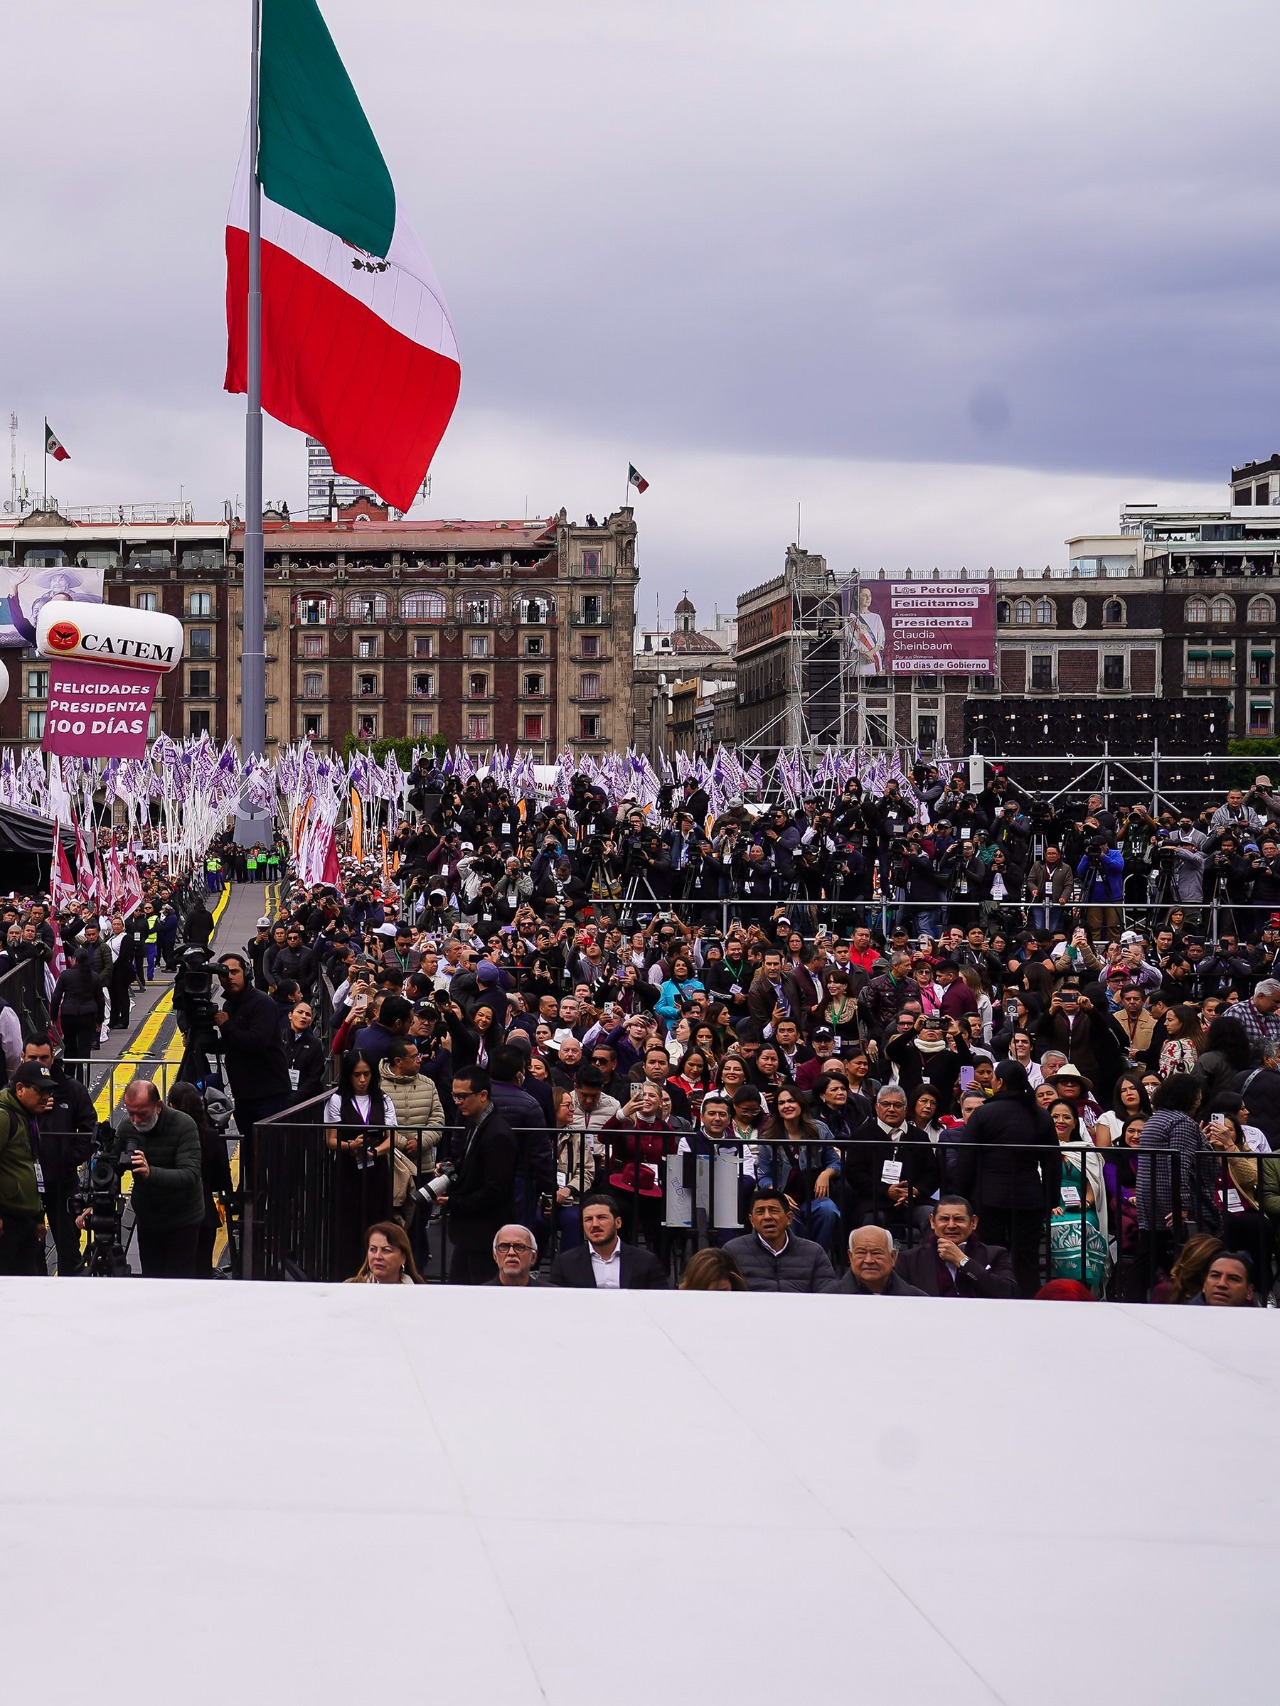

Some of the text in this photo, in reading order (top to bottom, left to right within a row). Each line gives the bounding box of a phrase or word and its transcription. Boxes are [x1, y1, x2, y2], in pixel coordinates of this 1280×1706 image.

[895, 586, 986, 594] L@s Petroler@s
[895, 599, 974, 607] Felicitamos
[895, 619, 969, 627] Presidenta
[893, 630, 935, 639] Claudia
[81, 634, 175, 662] CATEM
[893, 641, 953, 650] Sheinbaum
[913, 661, 931, 669] días
[933, 661, 944, 669] de
[947, 661, 986, 669] Gobierno
[54, 682, 150, 694] FELICIDADES
[50, 700, 147, 713] PRESIDENTA
[50, 717, 144, 735] 100 DÍAS
